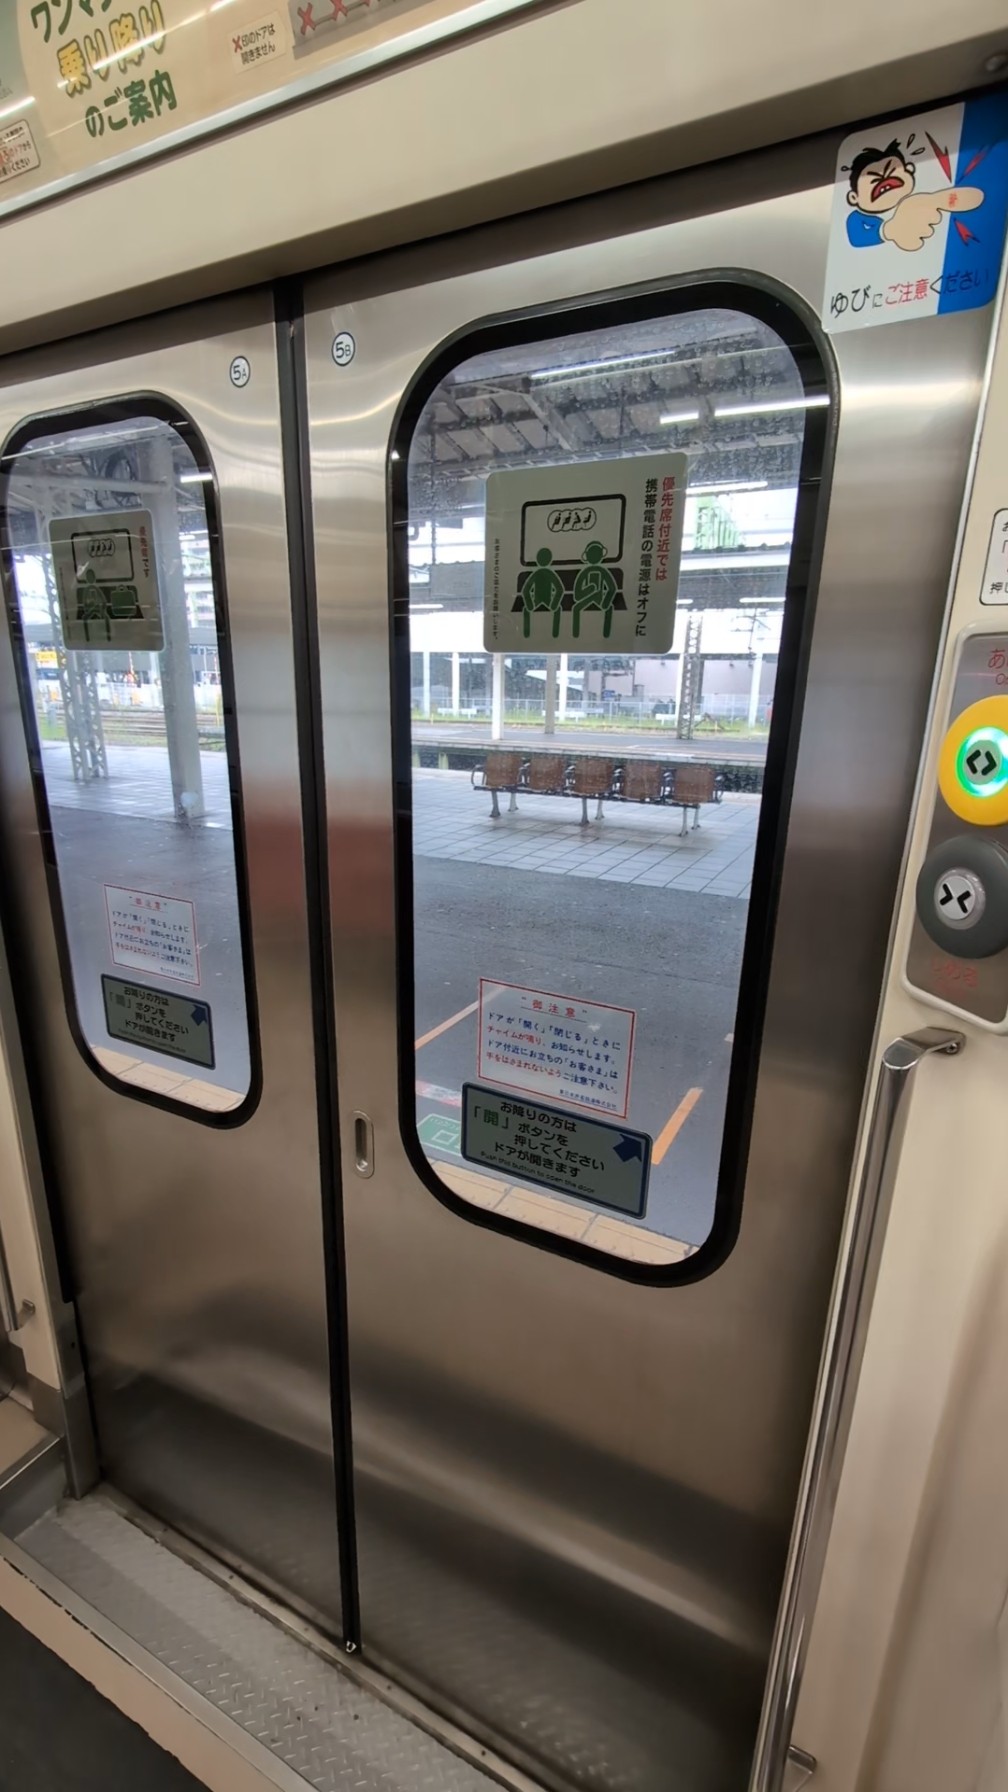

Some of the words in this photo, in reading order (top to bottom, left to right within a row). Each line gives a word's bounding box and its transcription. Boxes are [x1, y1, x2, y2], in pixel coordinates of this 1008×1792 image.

[31, 0, 112, 43] ワン
[56, 0, 167, 98] 乗り降り
[240, 41, 276, 65] 開きません
[86, 69, 177, 138] のご案内
[830, 269, 989, 319] ゆびにご注意ください
[335, 341, 351, 359] 5B
[233, 365, 247, 381] 5A
[655, 476, 676, 582] 優先席付近では
[635, 478, 659, 638] 携帯電話の電源はオフに
[988, 648, 1008, 670] あ
[500, 1101, 577, 1132] お降りの方は
[494, 1142, 580, 1178] ドアが開きます
[514, 1134, 605, 1171] 押してください
